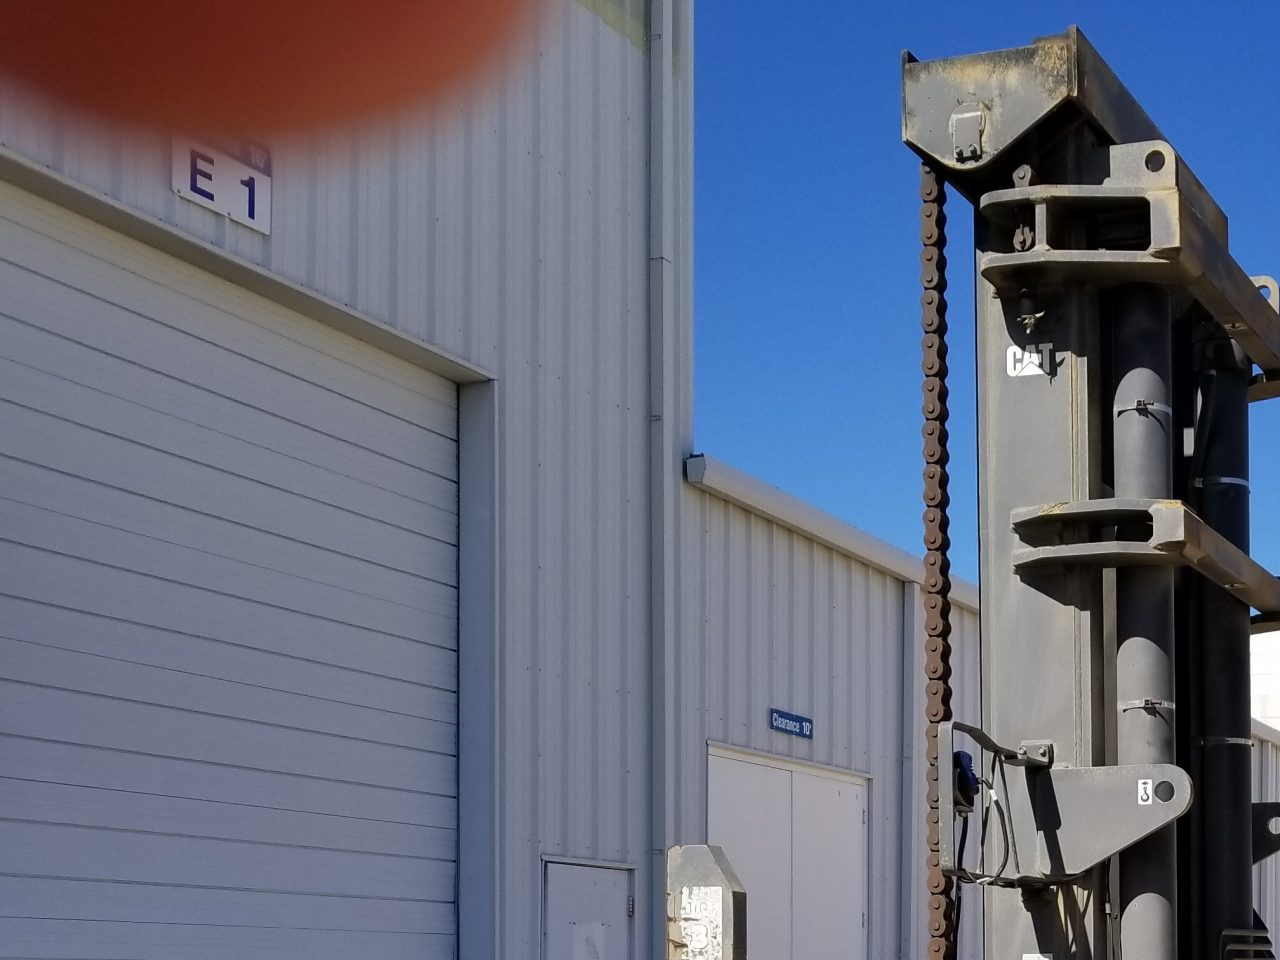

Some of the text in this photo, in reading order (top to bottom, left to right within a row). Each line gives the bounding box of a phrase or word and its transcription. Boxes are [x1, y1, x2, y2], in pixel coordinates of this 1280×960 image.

[190, 149, 255, 220] E 1
[1006, 342, 1054, 377] CAT
[772, 712, 800, 733] Clearance
